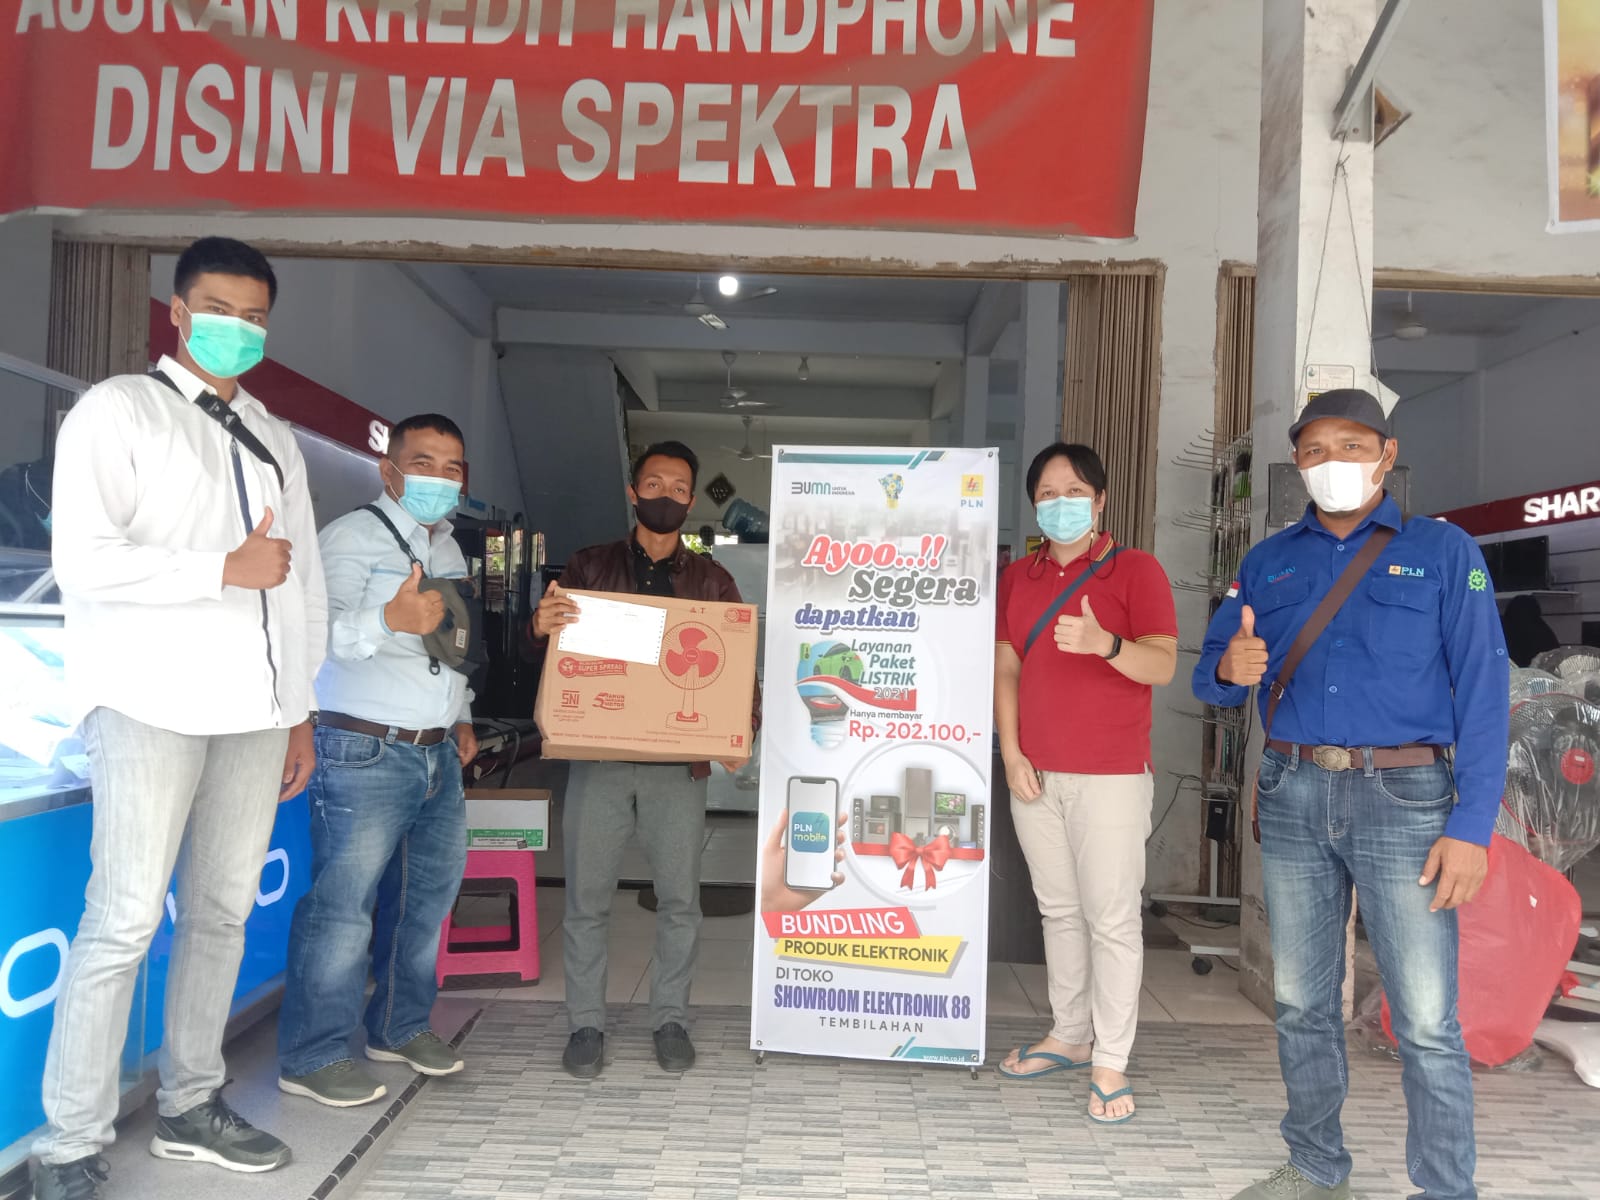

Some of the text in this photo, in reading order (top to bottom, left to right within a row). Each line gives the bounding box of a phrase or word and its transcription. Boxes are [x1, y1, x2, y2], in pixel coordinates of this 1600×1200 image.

[612, 0, 1076, 57] HANDPHONE
[90, 64, 977, 191] DISINI VIA SPEKTRA
[961, 499, 984, 509] PLN
[1401, 566, 1425, 577] PLN
[848, 569, 977, 608] Segera
[795, 603, 917, 631] dapatkan
[851, 639, 912, 654] Layanan
[869, 654, 916, 670] Paket
[860, 671, 917, 686] LISTRIK
[561, 692, 580, 705] SNI
[873, 687, 910, 700] 2021
[850, 709, 923, 721] Hanya membayar
[849, 720, 982, 744] Rp. 202.100,-
[794, 823, 813, 832] PLN
[794, 832, 827, 843] mobile
[781, 911, 905, 935] BUNDLING
[784, 940, 949, 963] PRODUK ELEKTRONIK
[776, 967, 834, 983] DI TOKO
[774, 984, 971, 1020] SHOWROOM ELEKTRONIK 88
[819, 1016, 924, 1033] TEMBILAHAN
